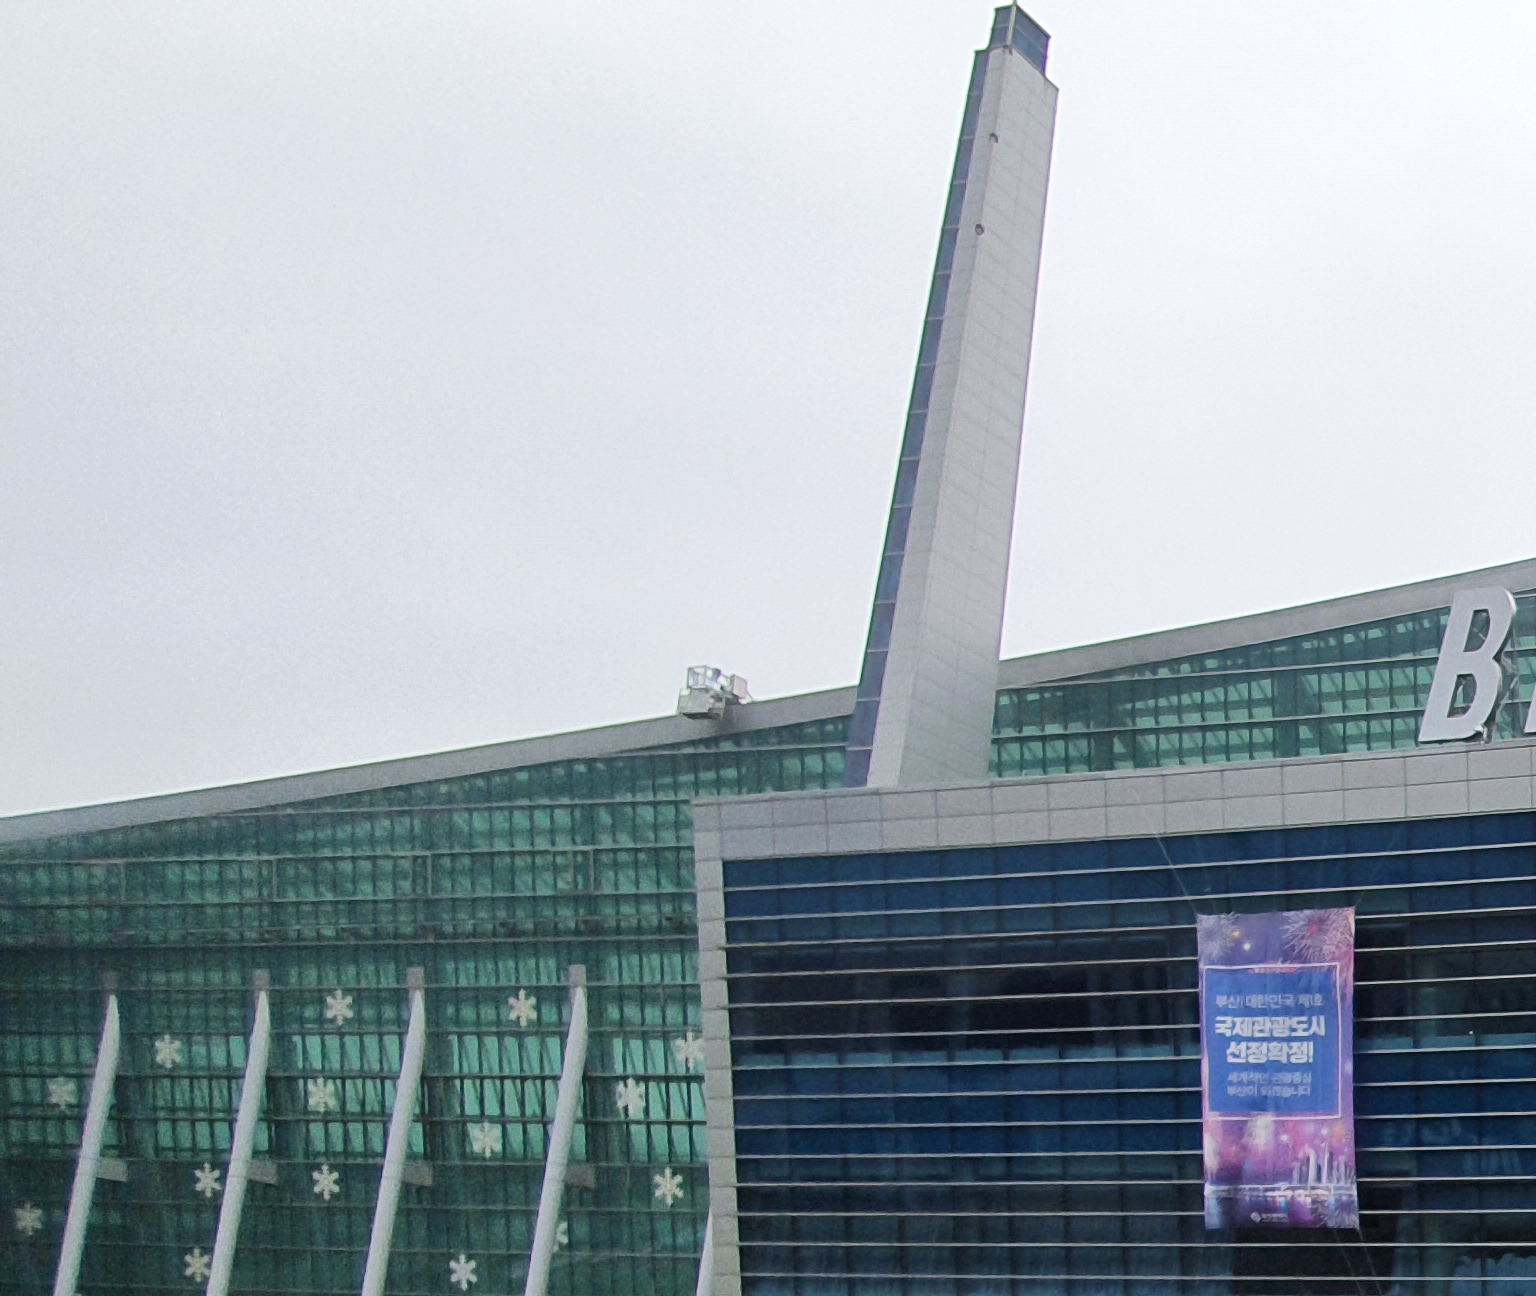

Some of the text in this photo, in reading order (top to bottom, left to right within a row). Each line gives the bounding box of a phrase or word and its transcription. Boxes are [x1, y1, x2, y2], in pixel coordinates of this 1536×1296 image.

[1245, 994, 1294, 1009] 대한민국
[1215, 1015, 1326, 1037] 국제관광도시
[1226, 1041, 1314, 1064] 선정확정!
